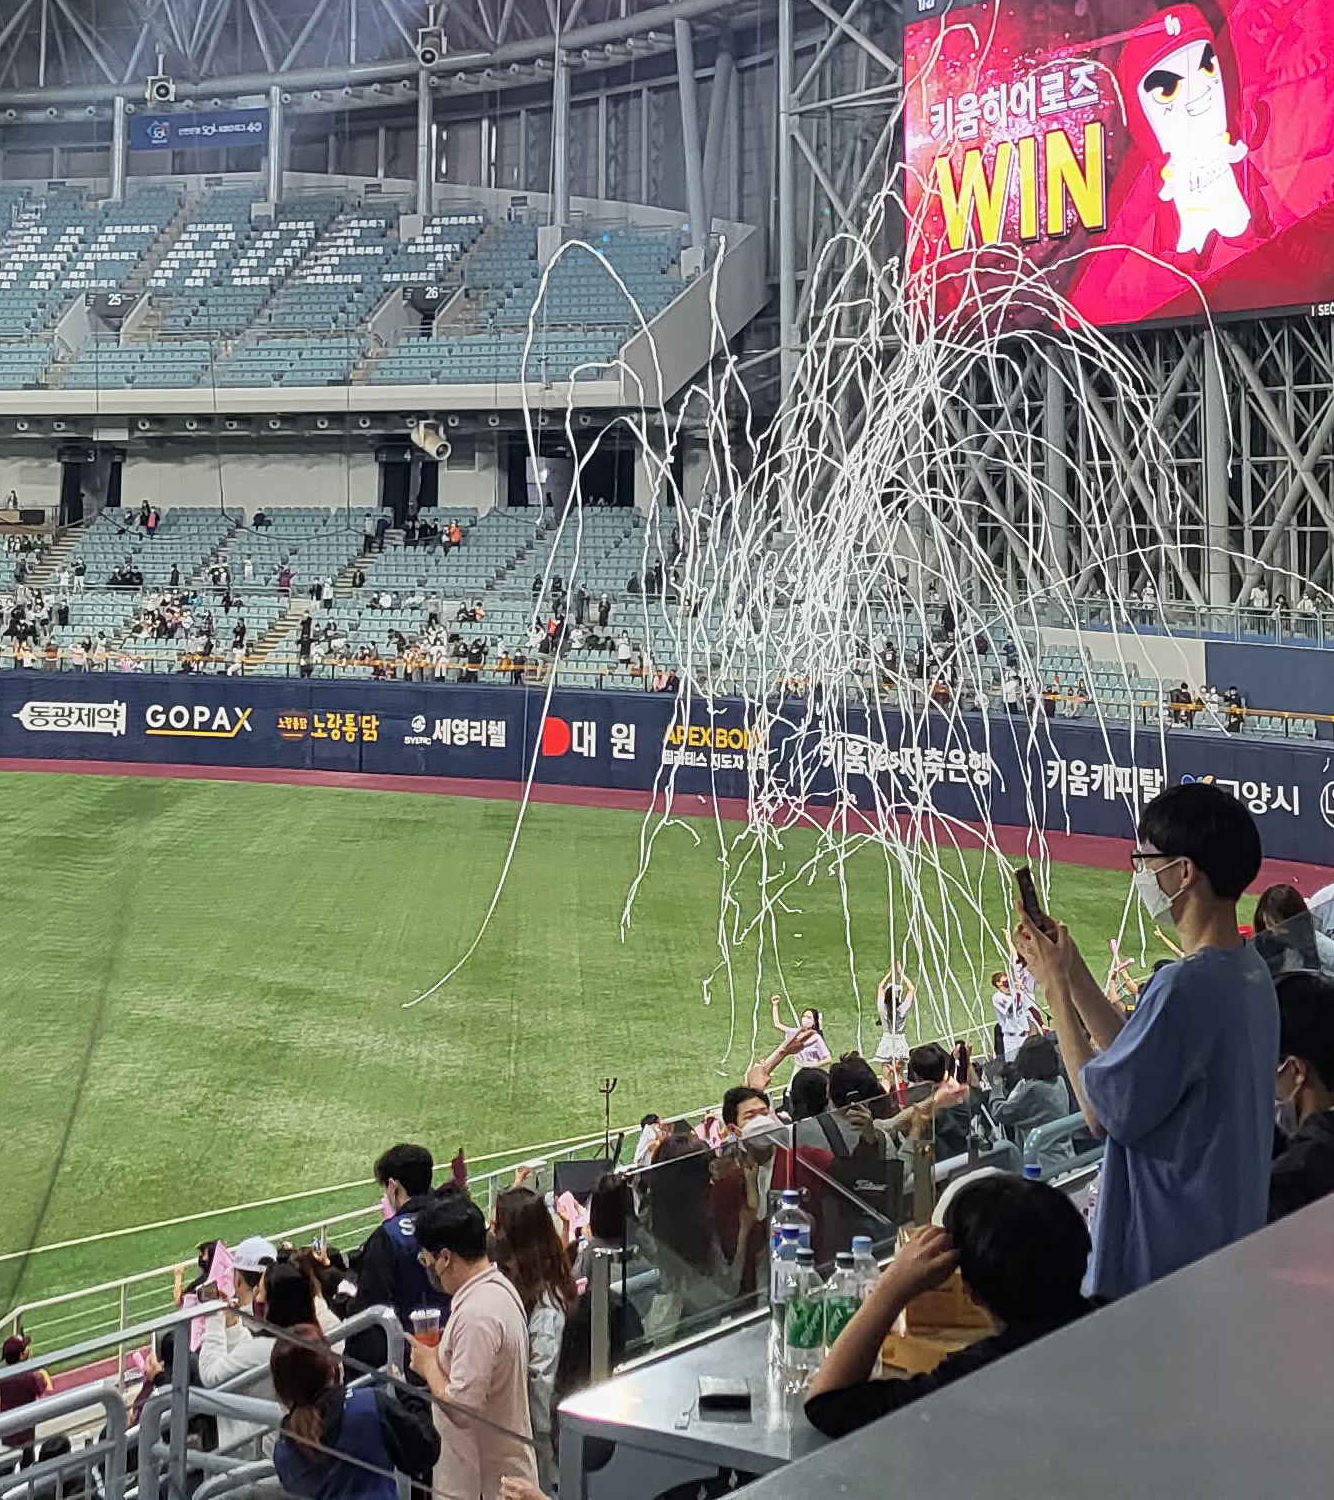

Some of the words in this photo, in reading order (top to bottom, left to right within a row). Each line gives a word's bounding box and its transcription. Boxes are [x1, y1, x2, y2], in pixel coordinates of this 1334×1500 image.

[930, 63, 1100, 143] 키움히어로즈
[935, 121, 1107, 250] WIN
[107, 293, 122, 306] 25
[424, 286, 439, 299] 26
[87, 449, 95, 462] 3
[403, 449, 412, 461] 4
[28, 705, 120, 729] 동광제약
[145, 704, 254, 732] GOPAX
[310, 713, 380, 743] 노랑통닭
[432, 718, 507, 748] 세영리첼
[662, 723, 711, 747] APEX
[1047, 758, 1165, 805] 키움캐피탈
